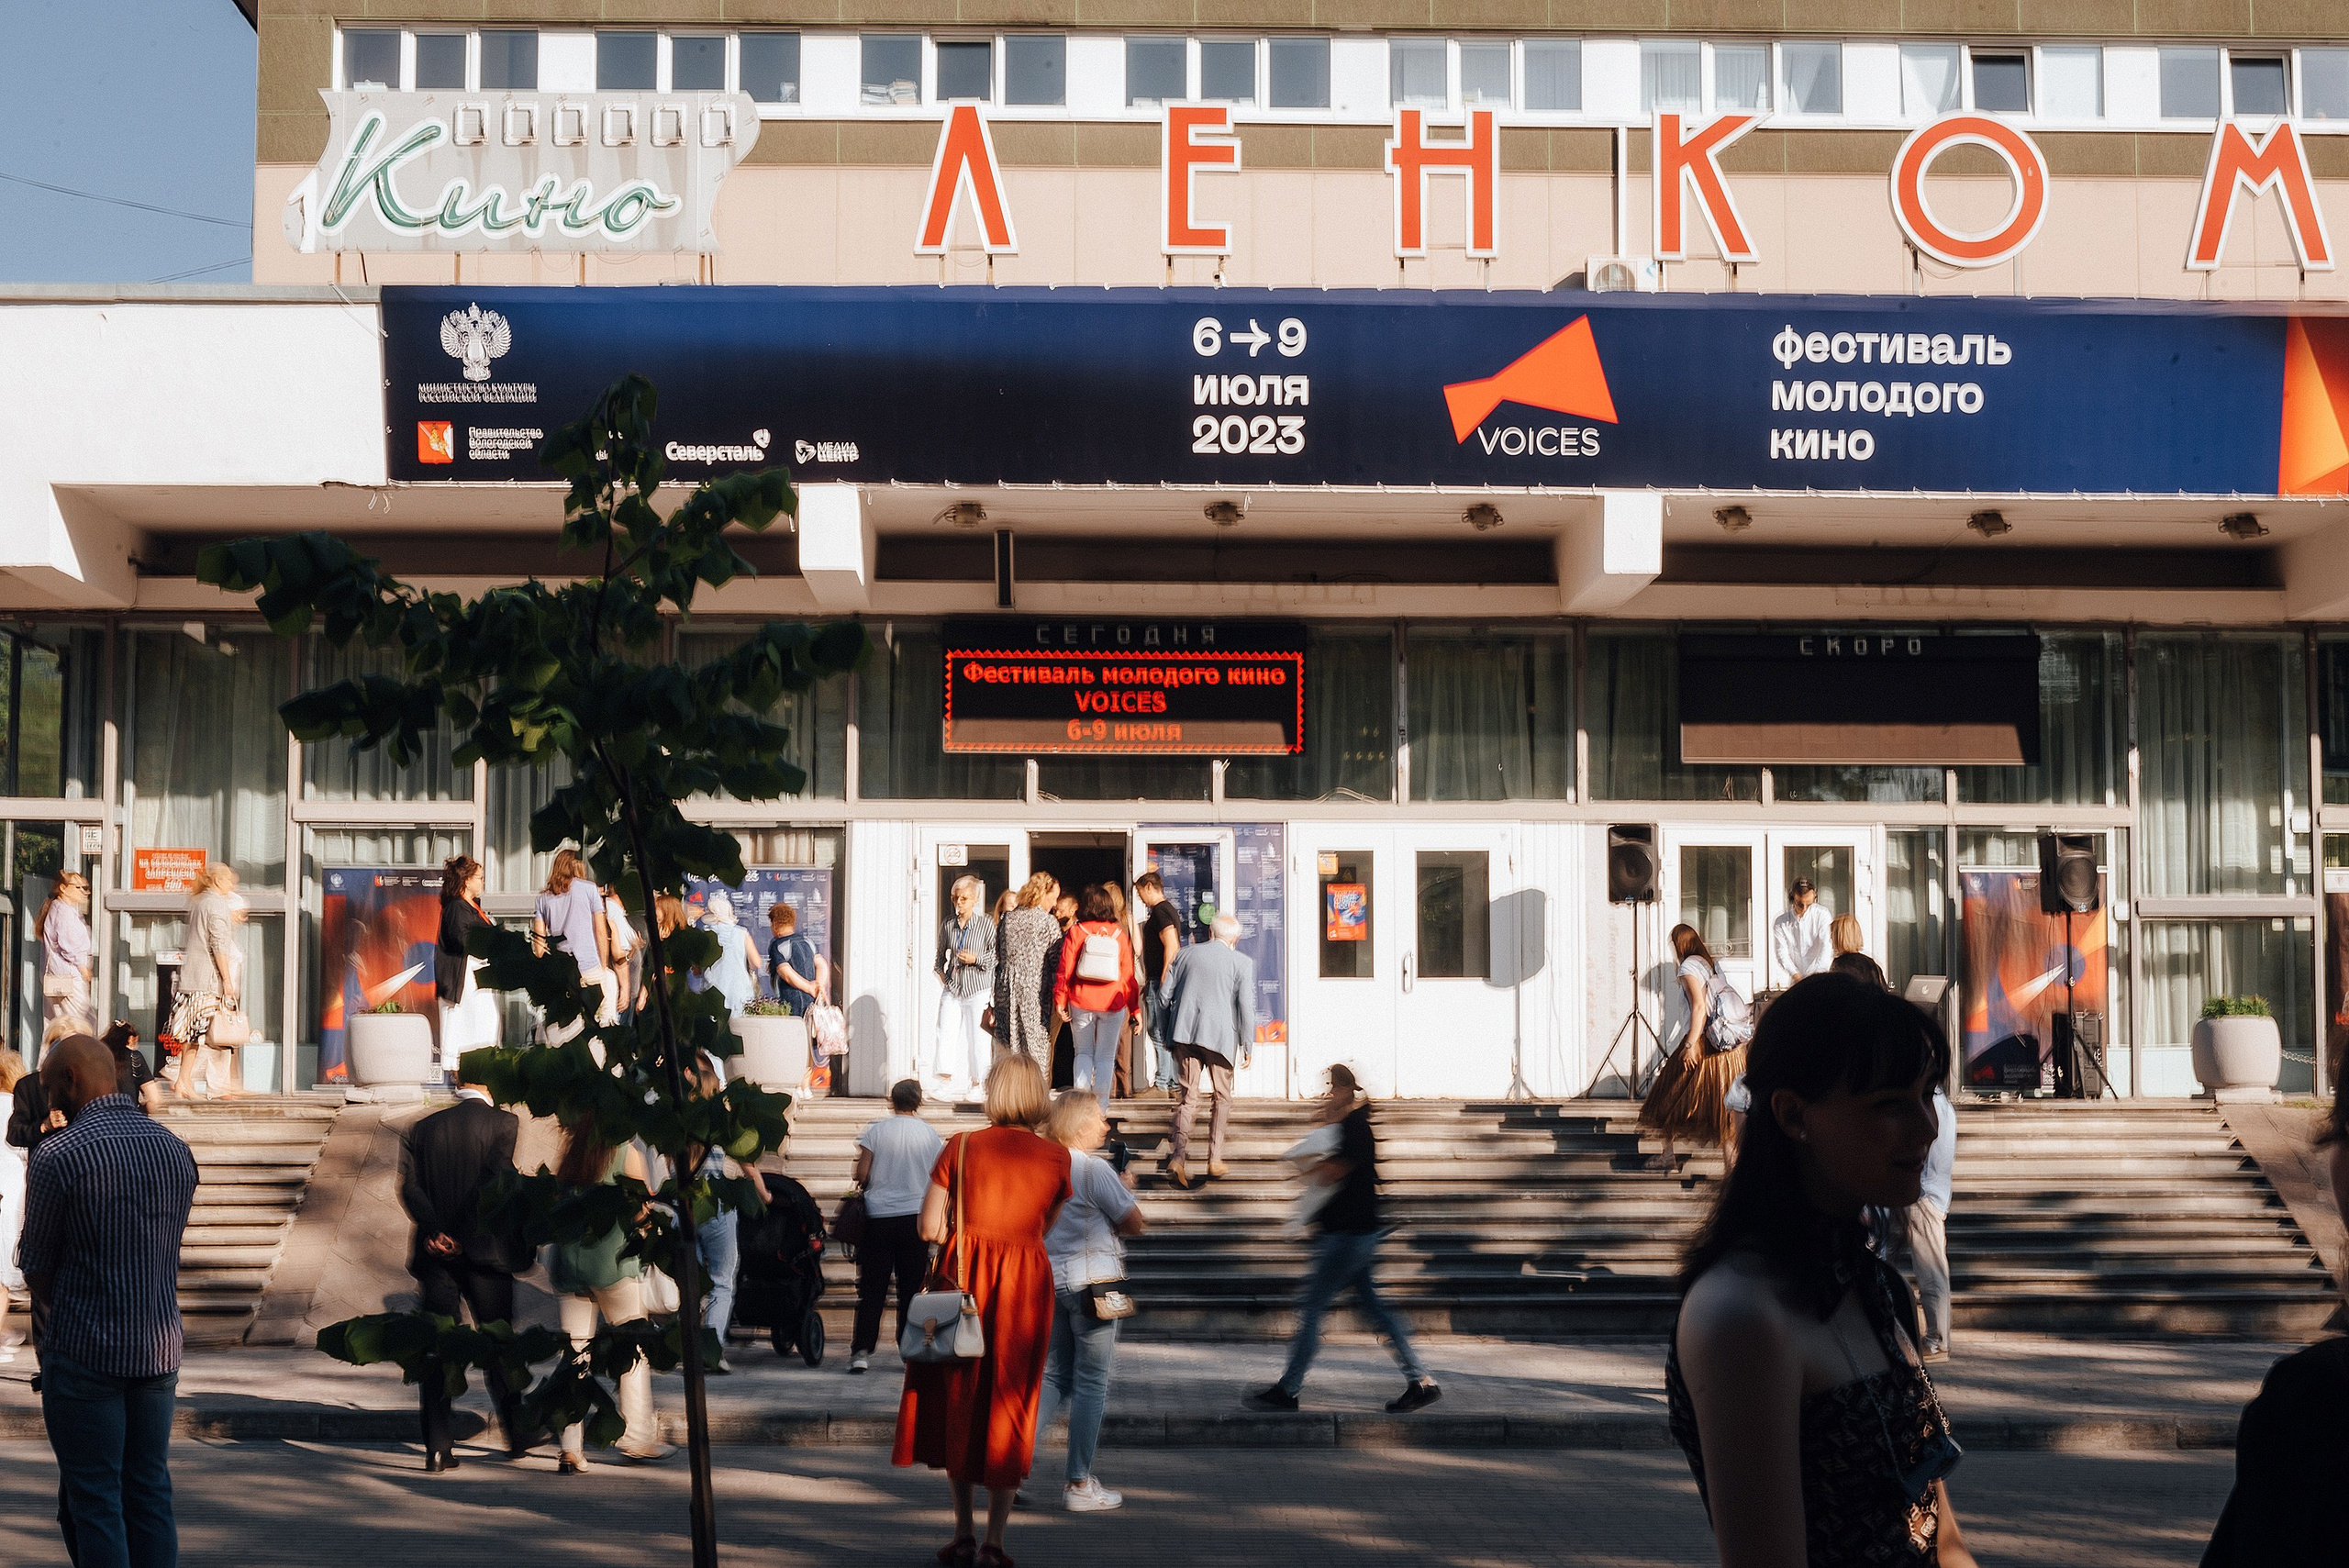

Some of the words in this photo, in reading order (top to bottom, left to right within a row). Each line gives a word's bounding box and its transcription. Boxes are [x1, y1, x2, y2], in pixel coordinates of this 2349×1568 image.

[321, 113, 679, 234] Кино
[1772, 324, 2012, 370] фестиваль
[1771, 380, 1985, 417] молодого
[469, 427, 543, 439] Правительство
[469, 438, 533, 450] Вологодской
[1192, 415, 1306, 454] 2023
[1478, 427, 1600, 456] VOICES
[1769, 428, 1876, 461] кино
[469, 449, 510, 460] области
[665, 441, 764, 465] Северсталь
[818, 441, 858, 452] МЕДИА
[818, 450, 859, 462] ЦЕНТР
[1036, 624, 1216, 646] СЕГОДНЯ
[1799, 637, 1922, 656] СКОРО
[963, 661, 1096, 684] Фестиваль
[1102, 665, 1220, 687] молодого
[1227, 667, 1286, 685] кино
[1074, 690, 1168, 713] VOICES
[1066, 718, 1108, 741] 6-9
[1114, 725, 1182, 741] июля
